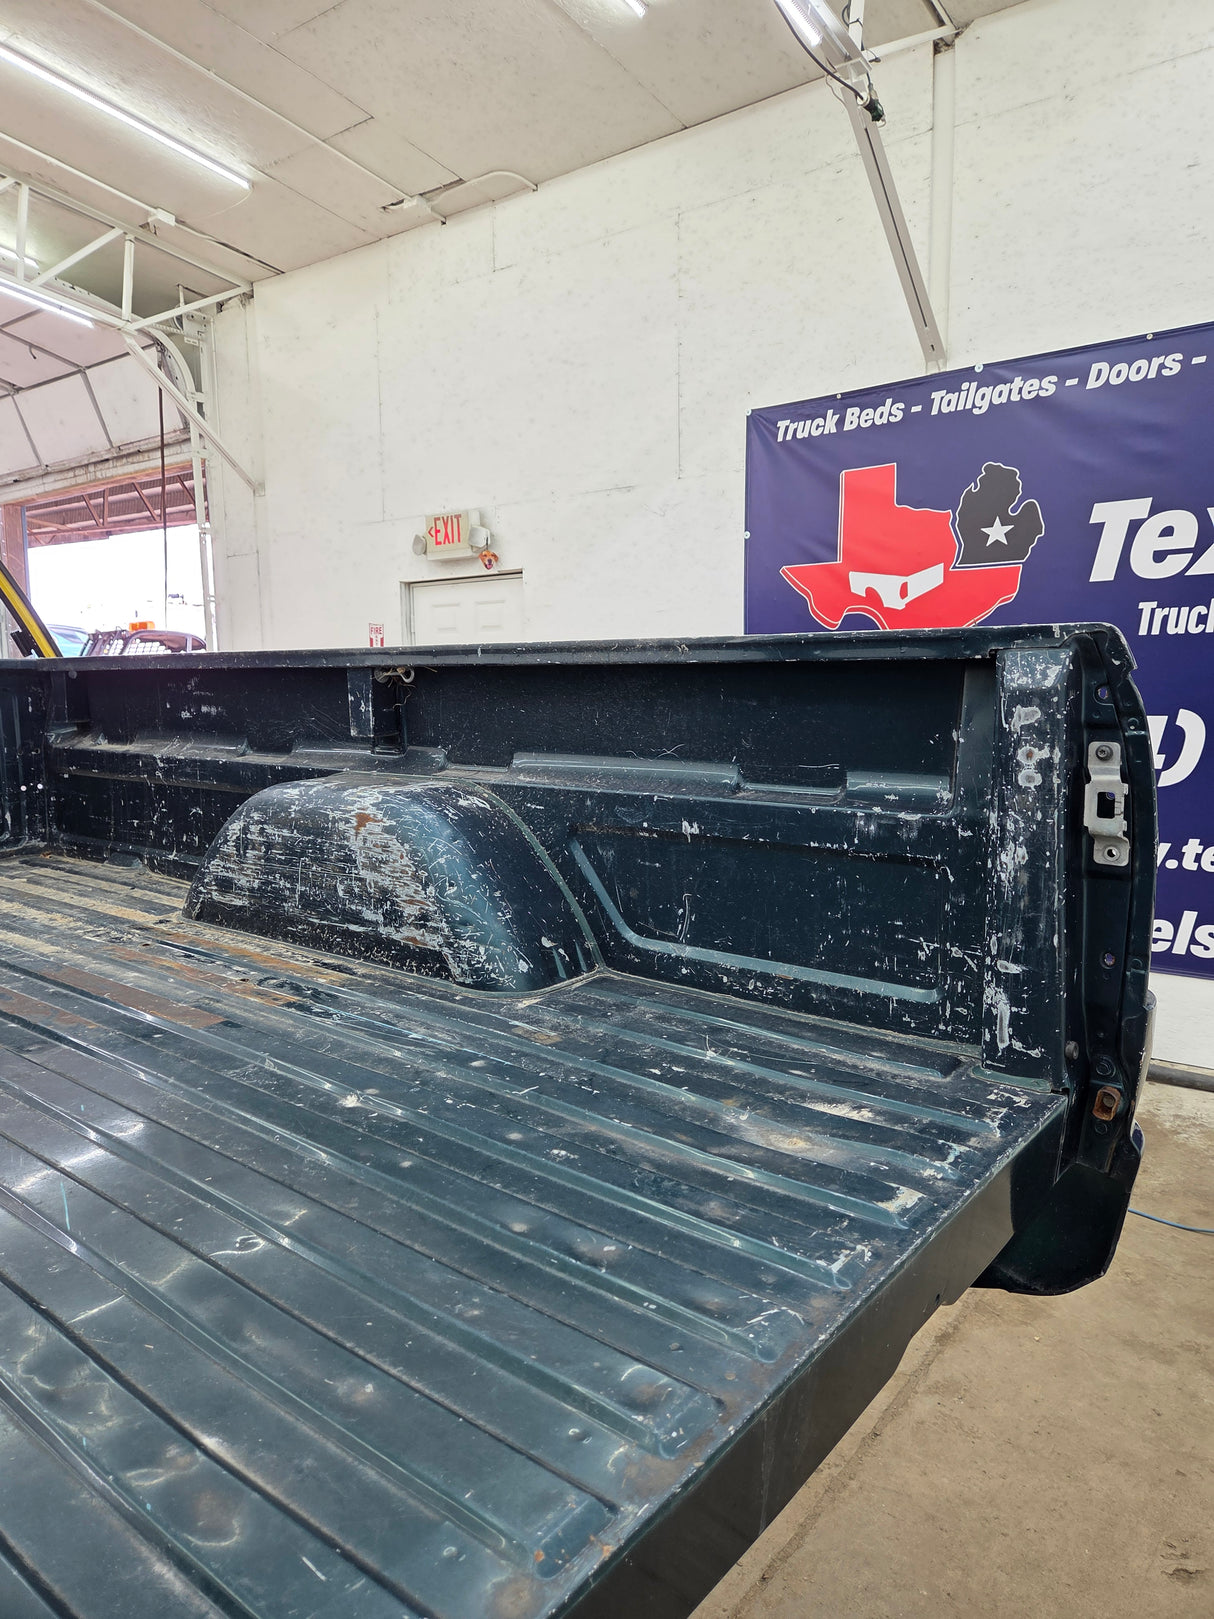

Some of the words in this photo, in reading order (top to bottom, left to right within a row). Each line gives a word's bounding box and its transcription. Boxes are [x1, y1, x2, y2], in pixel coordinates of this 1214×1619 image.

[776, 408, 840, 442] Truck
[843, 398, 905, 431] Beds
[930, 375, 1058, 416] Tailgates
[1085, 352, 1184, 390] Doors
[434, 513, 462, 546] EXIT
[370, 626, 383, 635] FIRE
